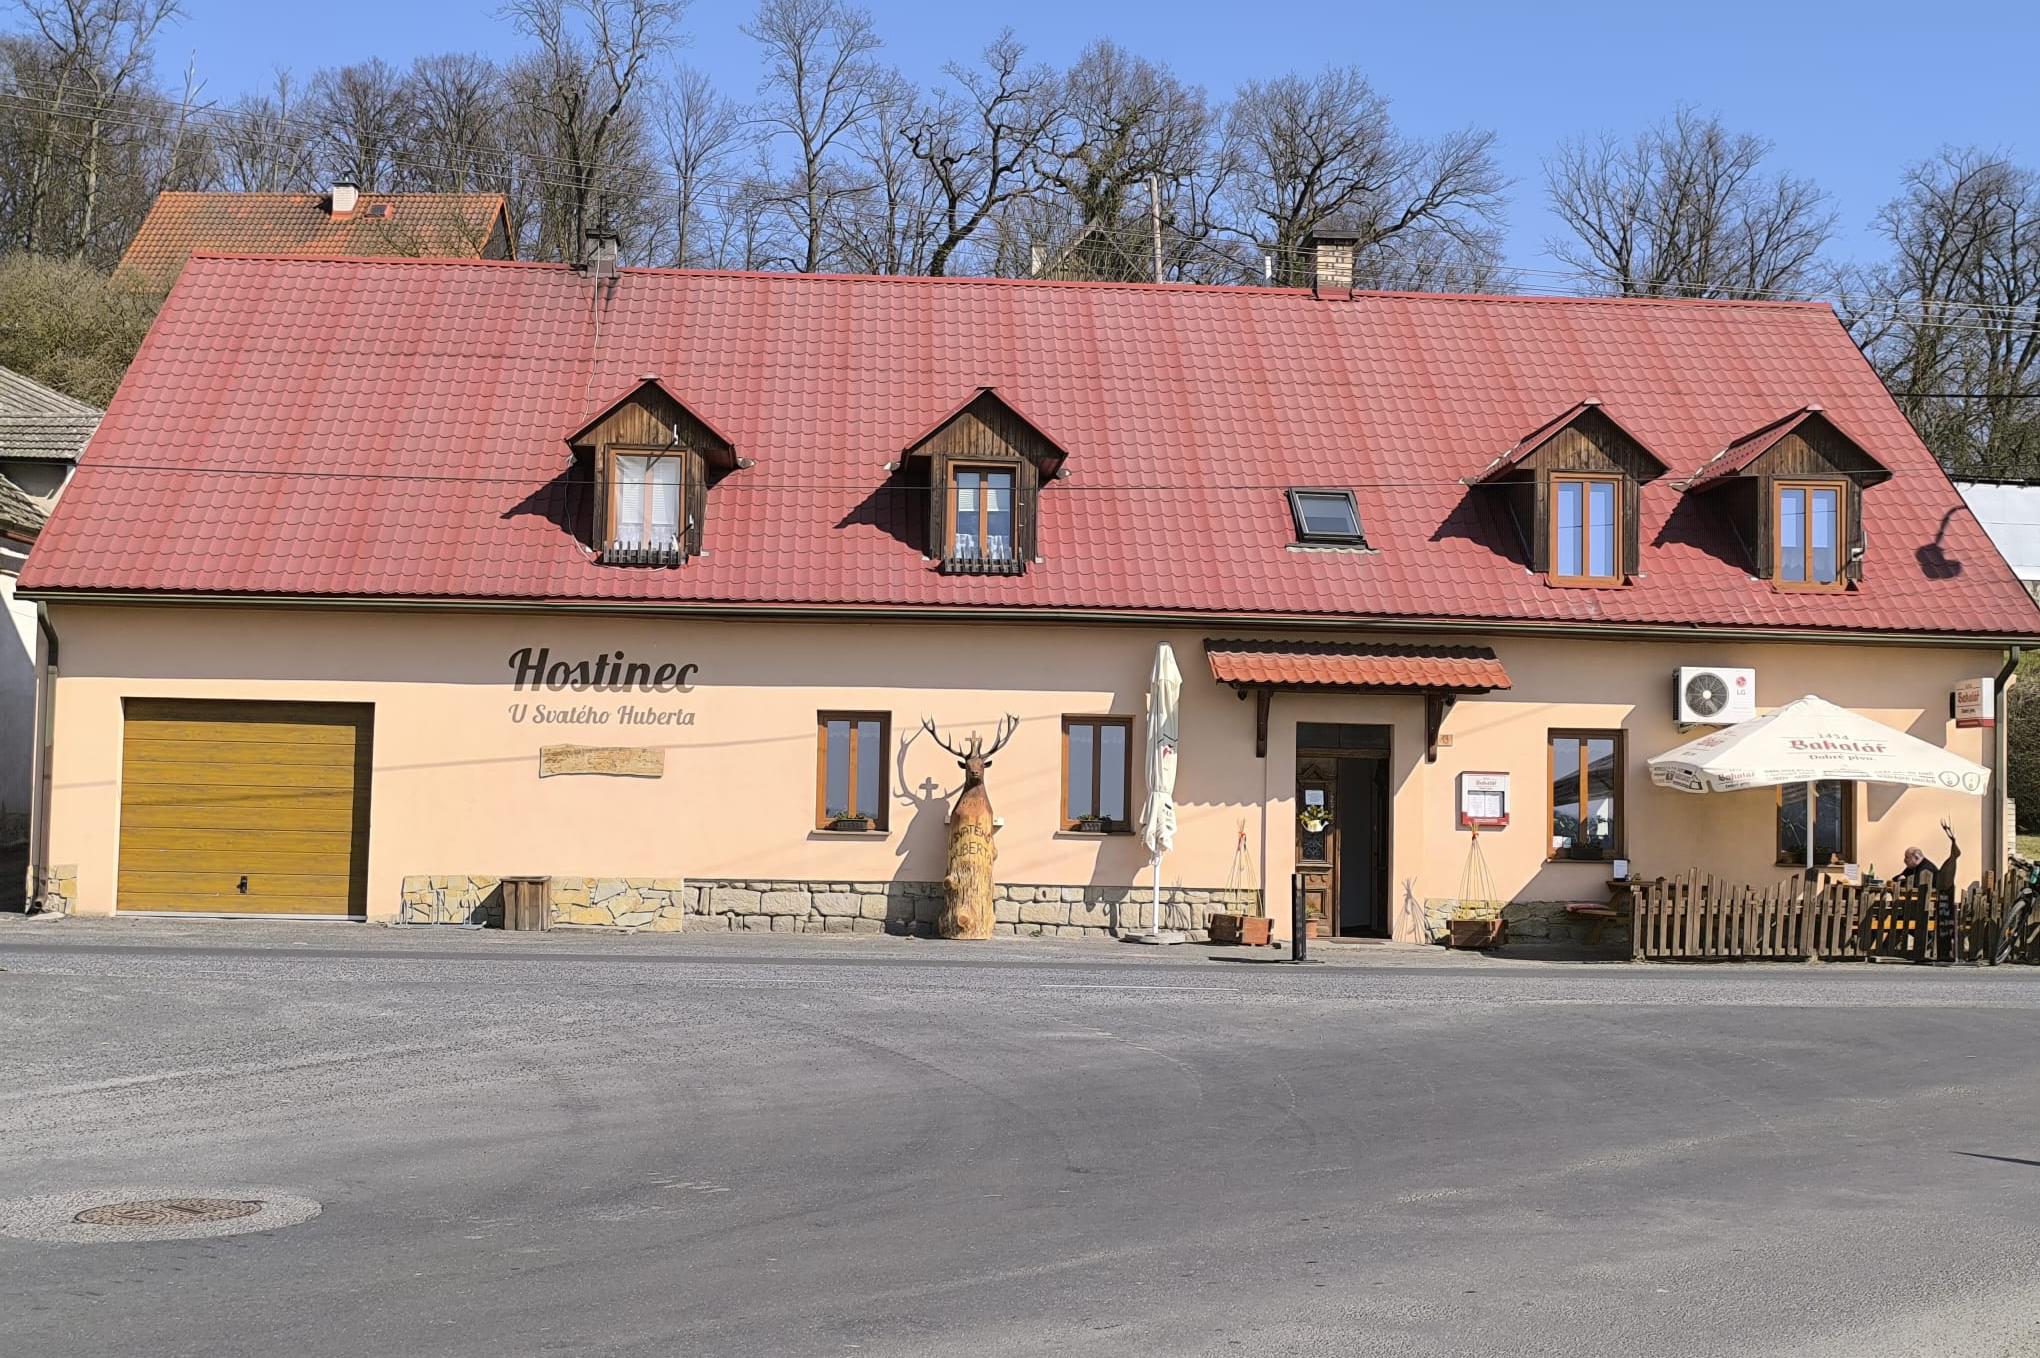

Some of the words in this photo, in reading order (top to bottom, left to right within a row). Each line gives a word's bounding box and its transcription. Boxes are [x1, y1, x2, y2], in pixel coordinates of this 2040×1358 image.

[508, 647, 699, 694] Hostinec
[508, 703, 528, 724] U
[532, 704, 610, 725] Svatého
[617, 705, 696, 726] Huberta
[1790, 739, 1887, 753] Bakalář
